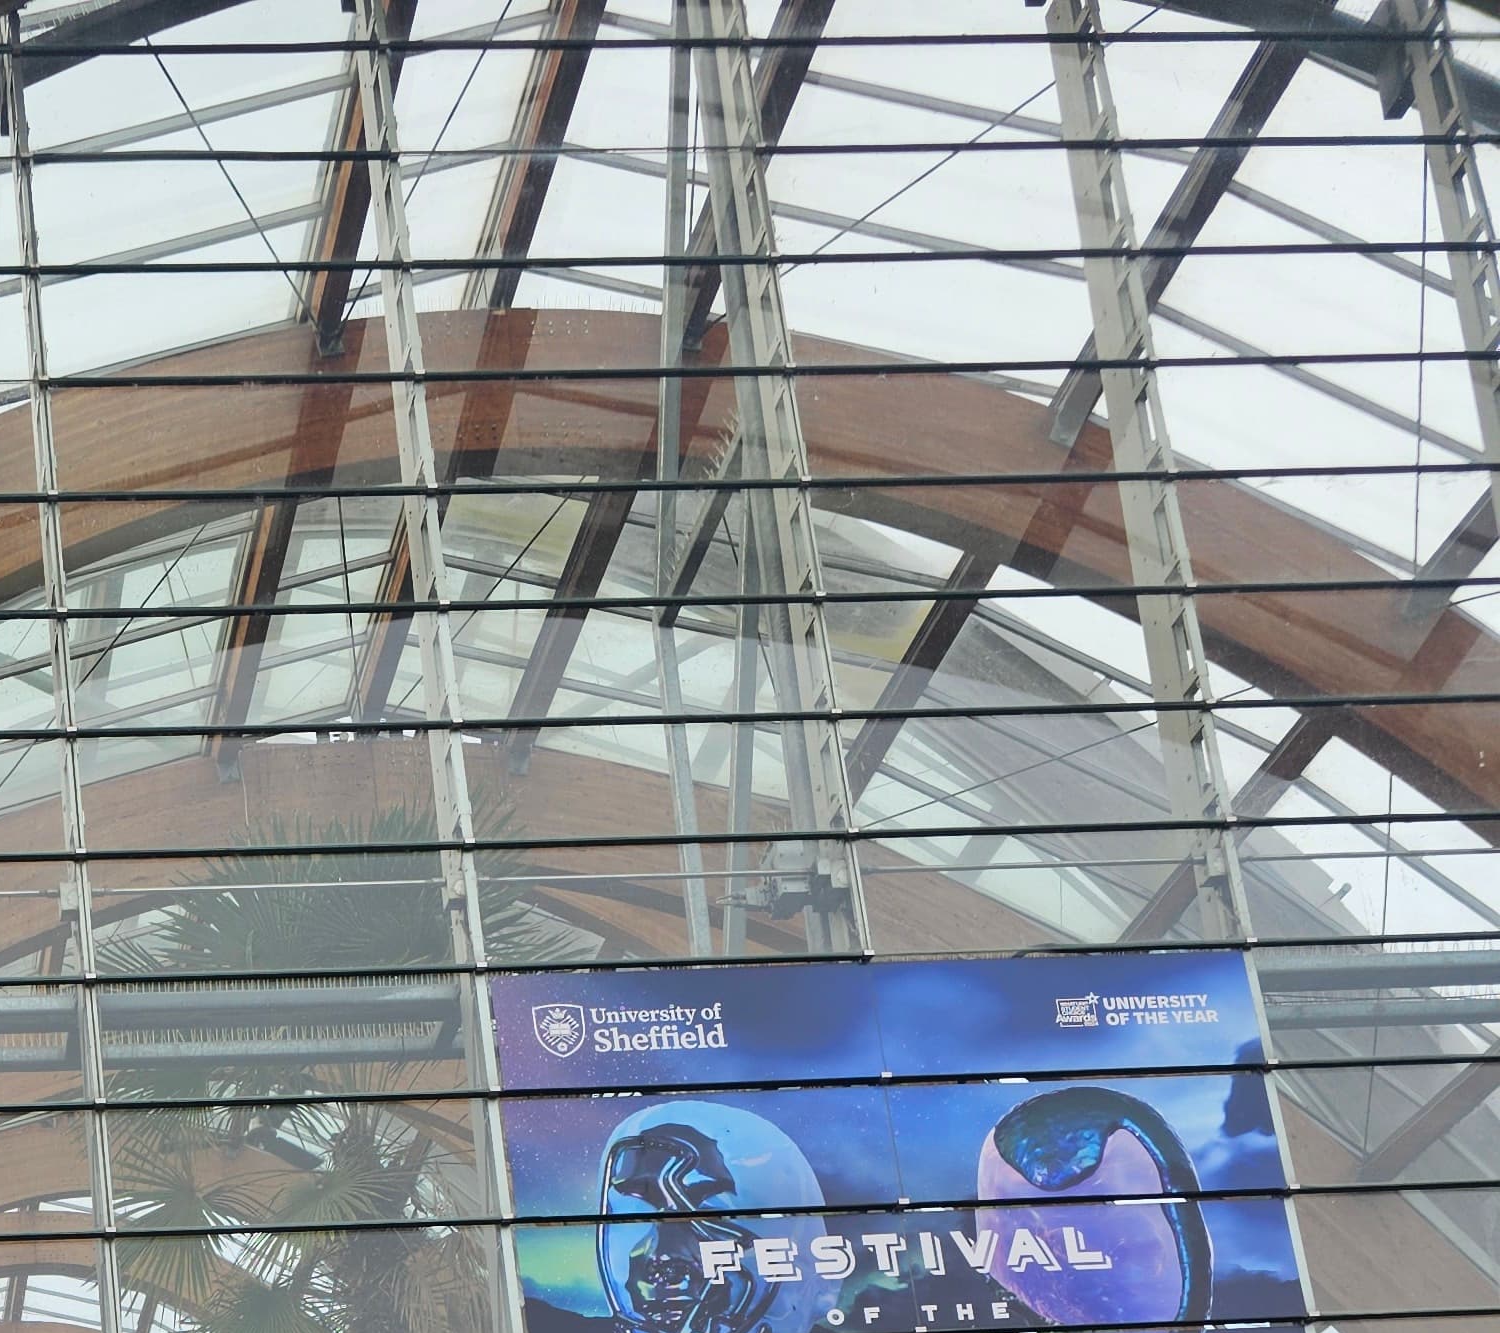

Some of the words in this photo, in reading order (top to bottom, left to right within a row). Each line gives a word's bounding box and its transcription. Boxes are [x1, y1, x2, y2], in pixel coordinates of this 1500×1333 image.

[589, 1003, 696, 1026] University
[701, 1002, 723, 1021] of
[1102, 994, 1208, 1011] UNIVERSITY
[1105, 1012, 1130, 1027] OF
[1132, 1011, 1169, 1025] THE
[1171, 1009, 1219, 1024] YEAR
[593, 1023, 728, 1053] Sheffield
[699, 1226, 1113, 1285] FESTIVAL
[826, 1306, 881, 1326] OF
[921, 1302, 1011, 1322] THE
